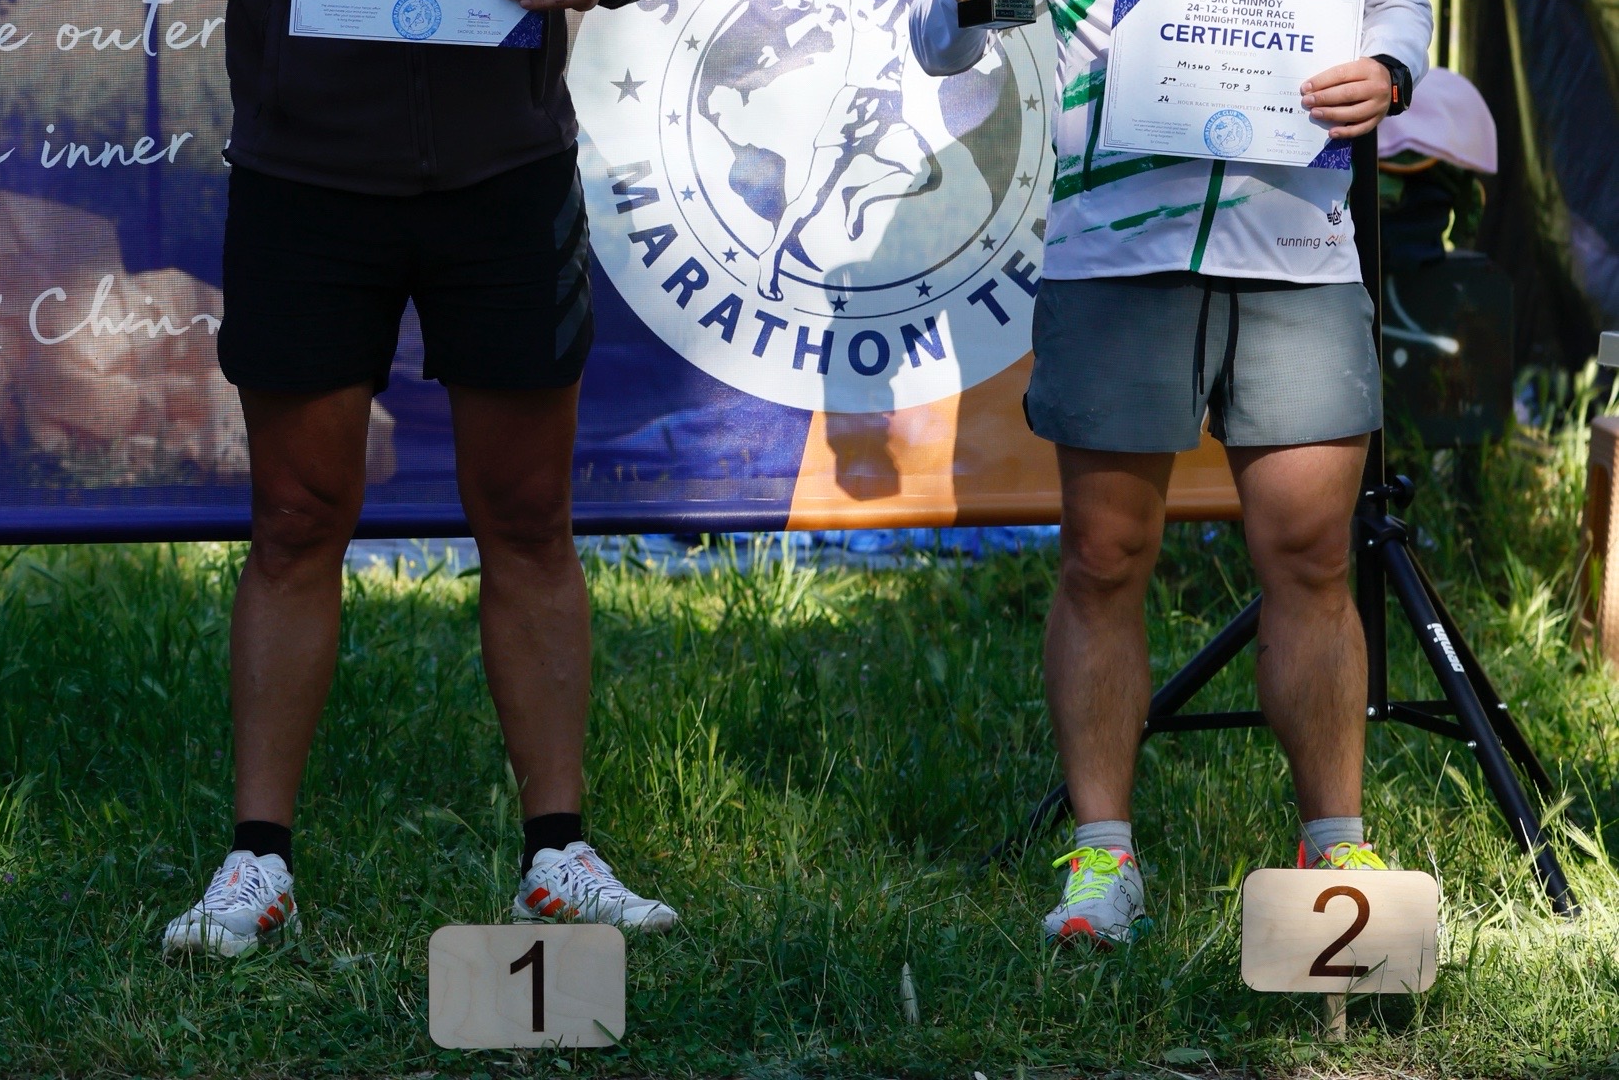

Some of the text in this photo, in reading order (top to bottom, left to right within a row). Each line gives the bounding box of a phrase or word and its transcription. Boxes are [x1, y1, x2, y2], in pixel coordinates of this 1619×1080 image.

[1184, 13, 1295, 29] & MIDNIGHT MARATHON
[1187, 2, 1295, 20] 24-12-6 HOUR RACE
[1160, 23, 1315, 53] CERTIFICATE
[1158, 95, 1169, 103] 24
[1219, 82, 1239, 90] TOP
[40, 124, 194, 169] inner
[1276, 236, 1321, 249] running
[606, 158, 948, 378] MARATHON
[28, 274, 223, 346] Chin
[1309, 885, 1370, 977] 2
[510, 940, 545, 1032] 1
